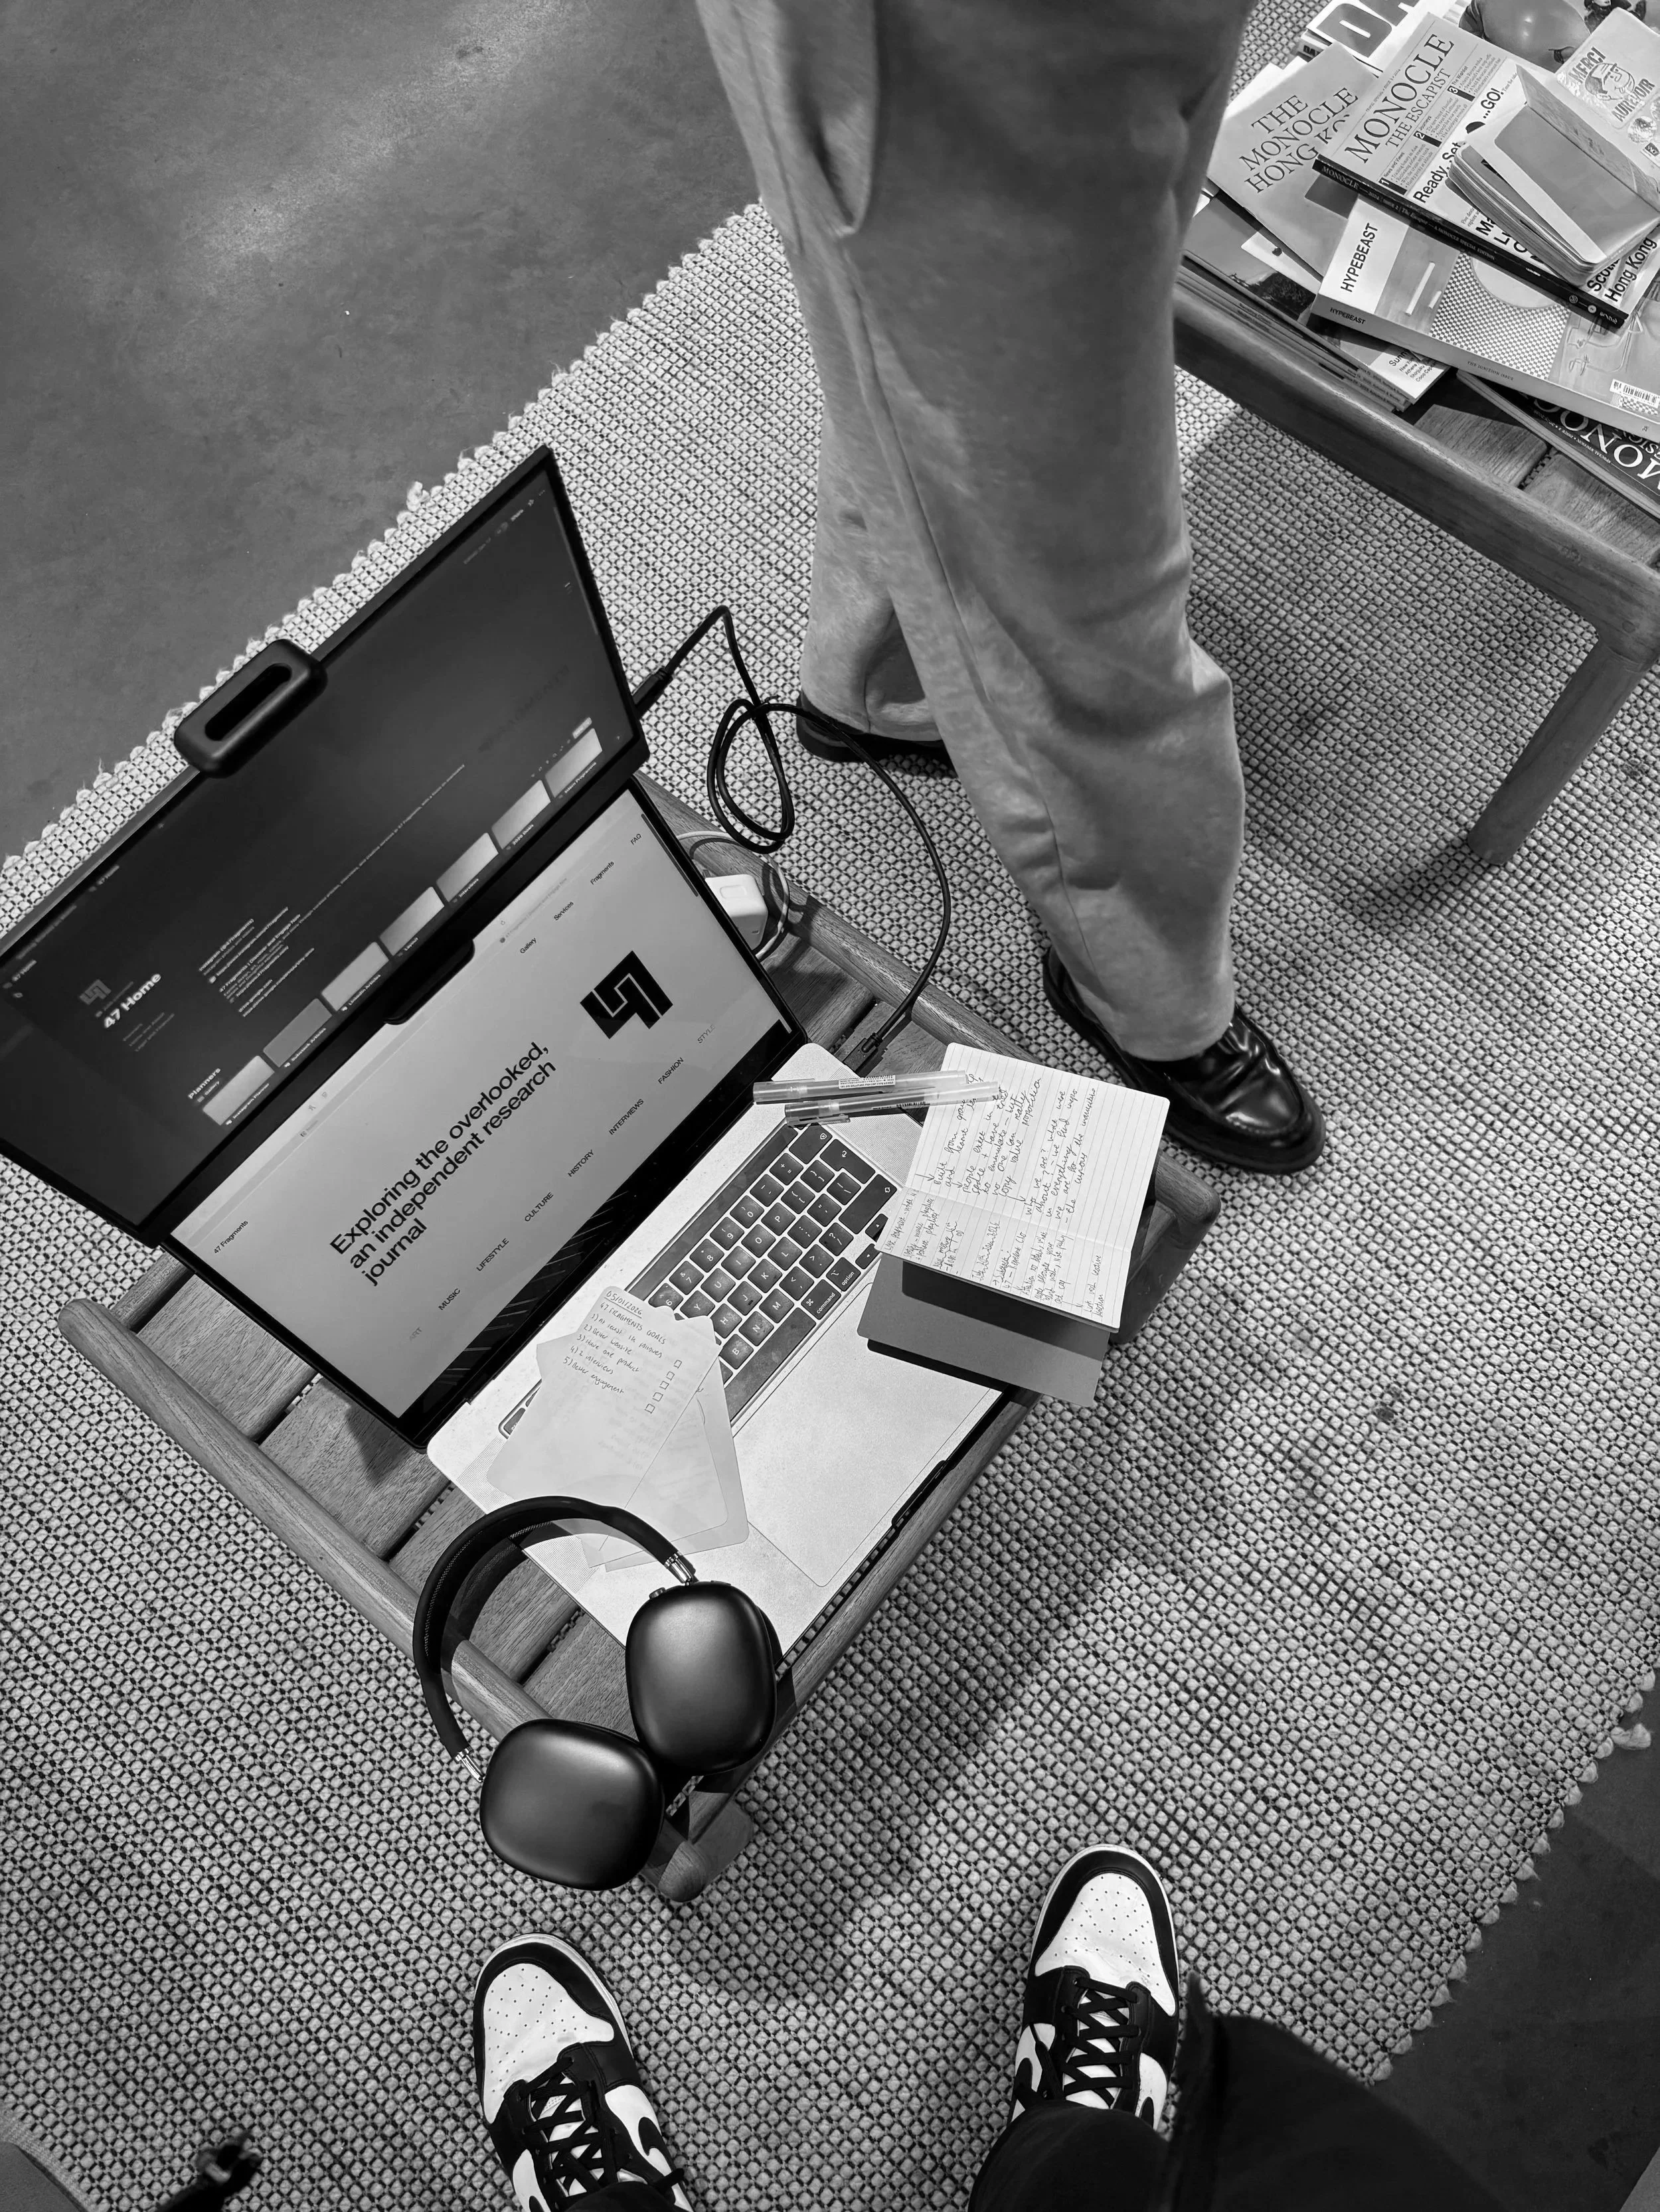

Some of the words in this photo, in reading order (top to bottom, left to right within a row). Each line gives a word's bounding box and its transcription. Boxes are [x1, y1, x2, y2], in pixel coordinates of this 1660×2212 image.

[1448, 84, 1459, 96] 3
[1568, 46, 1606, 84] MERCI
[1251, 95, 1308, 133] THE
[1345, 35, 1453, 162] MONOCLE
[1384, 121, 1412, 147] THE
[1405, 68, 1450, 123] ESCAPIST
[1240, 88, 1358, 170] MONOCLE
[1415, 129, 1425, 141] 2
[1244, 143, 1321, 193] HONG
[1321, 165, 1359, 190] MONOCLE
[1341, 222, 1377, 292] HYPEBEAST
[1604, 266, 1637, 302] Hong
[1625, 235, 1657, 270] Kong
[1329, 307, 1366, 325] HYPEBEAST
[519, 937, 537, 954] Gallery
[553, 901, 574, 921] Services
[590, 861, 614, 885] Fragments
[630, 833, 642, 845] FAQ
[99, 1005, 126, 1032] 47
[121, 974, 161, 1010] Home
[188, 1067, 221, 1099] Planners
[330, 1170, 420, 1254] Exploring
[415, 1140, 449, 1170] the
[450, 1042, 548, 1139] overlooked,
[350, 1243, 376, 1269] an
[372, 1133, 484, 1243] independent
[483, 1062, 556, 1135] research
[438, 1288, 461, 1310] MUSIC
[476, 1237, 509, 1271] LIFESTYLE
[524, 1192, 554, 1222] CULTURE
[568, 1149, 594, 1177] HISTORY
[608, 1099, 644, 1135] INTERVIEWS
[657, 1057, 684, 1084] FASHION
[211, 1243, 223, 1255] 47
[220, 1220, 248, 1247] Fragments
[363, 1218, 426, 1286] journal
[683, 1275, 695, 1287] 7
[704, 1251, 716, 1264] 8
[724, 1229, 736, 1241] 9
[691, 1301, 703, 1313] Y
[712, 1279, 724, 1291] U
[772, 1213, 784, 1225] P
[606, 1290, 642, 1315] 05/01/2026
[718, 1314, 731, 1326] H
[739, 1291, 751, 1303] J
[758, 1269, 770, 1281] K
[780, 1247, 791, 1259] L
[816, 1292, 836, 1314] command
[841, 1271, 855, 1286] option
[570, 1345, 579, 1354] 4)
[583, 1323, 592, 1332] 2)
[598, 1300, 610, 1312] 47
[608, 1307, 643, 1331] FRAGMENTS
[646, 1330, 666, 1345] GOALS
[730, 1345, 742, 1358] B
[750, 1322, 763, 1335] N
[770, 1299, 784, 1312] M
[562, 1356, 574, 1366] 5)
